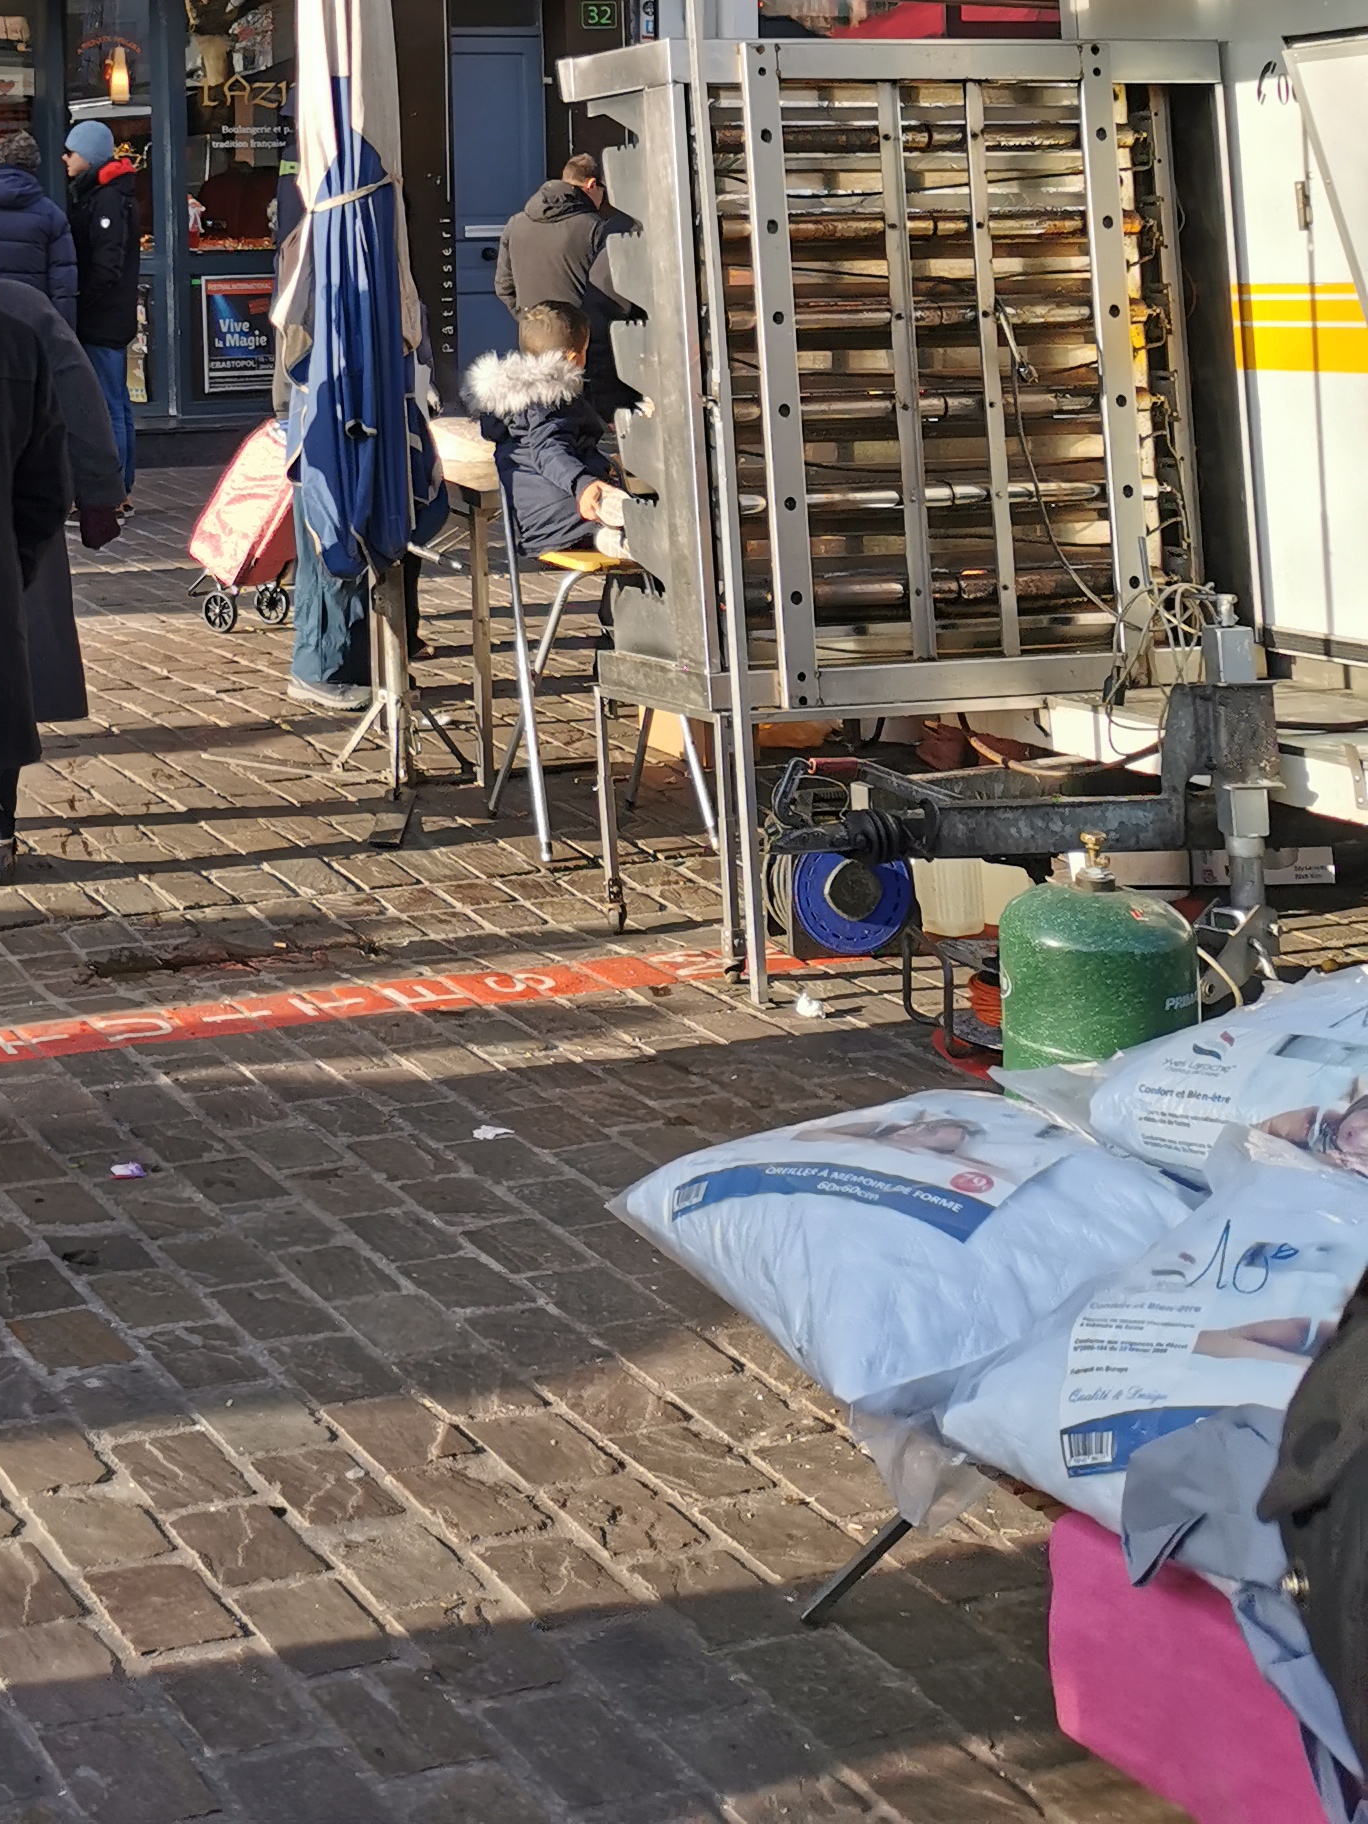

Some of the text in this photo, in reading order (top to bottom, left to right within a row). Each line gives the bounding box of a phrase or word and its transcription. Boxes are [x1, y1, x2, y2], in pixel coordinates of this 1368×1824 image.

[586, 4, 613, 25] 32
[219, 318, 251, 333] Vive
[225, 329, 268, 350] Magie
[1138, 1083, 1175, 1098] Confort
[1175, 1088, 1185, 1099] et
[912, 1188, 964, 1214] FORME
